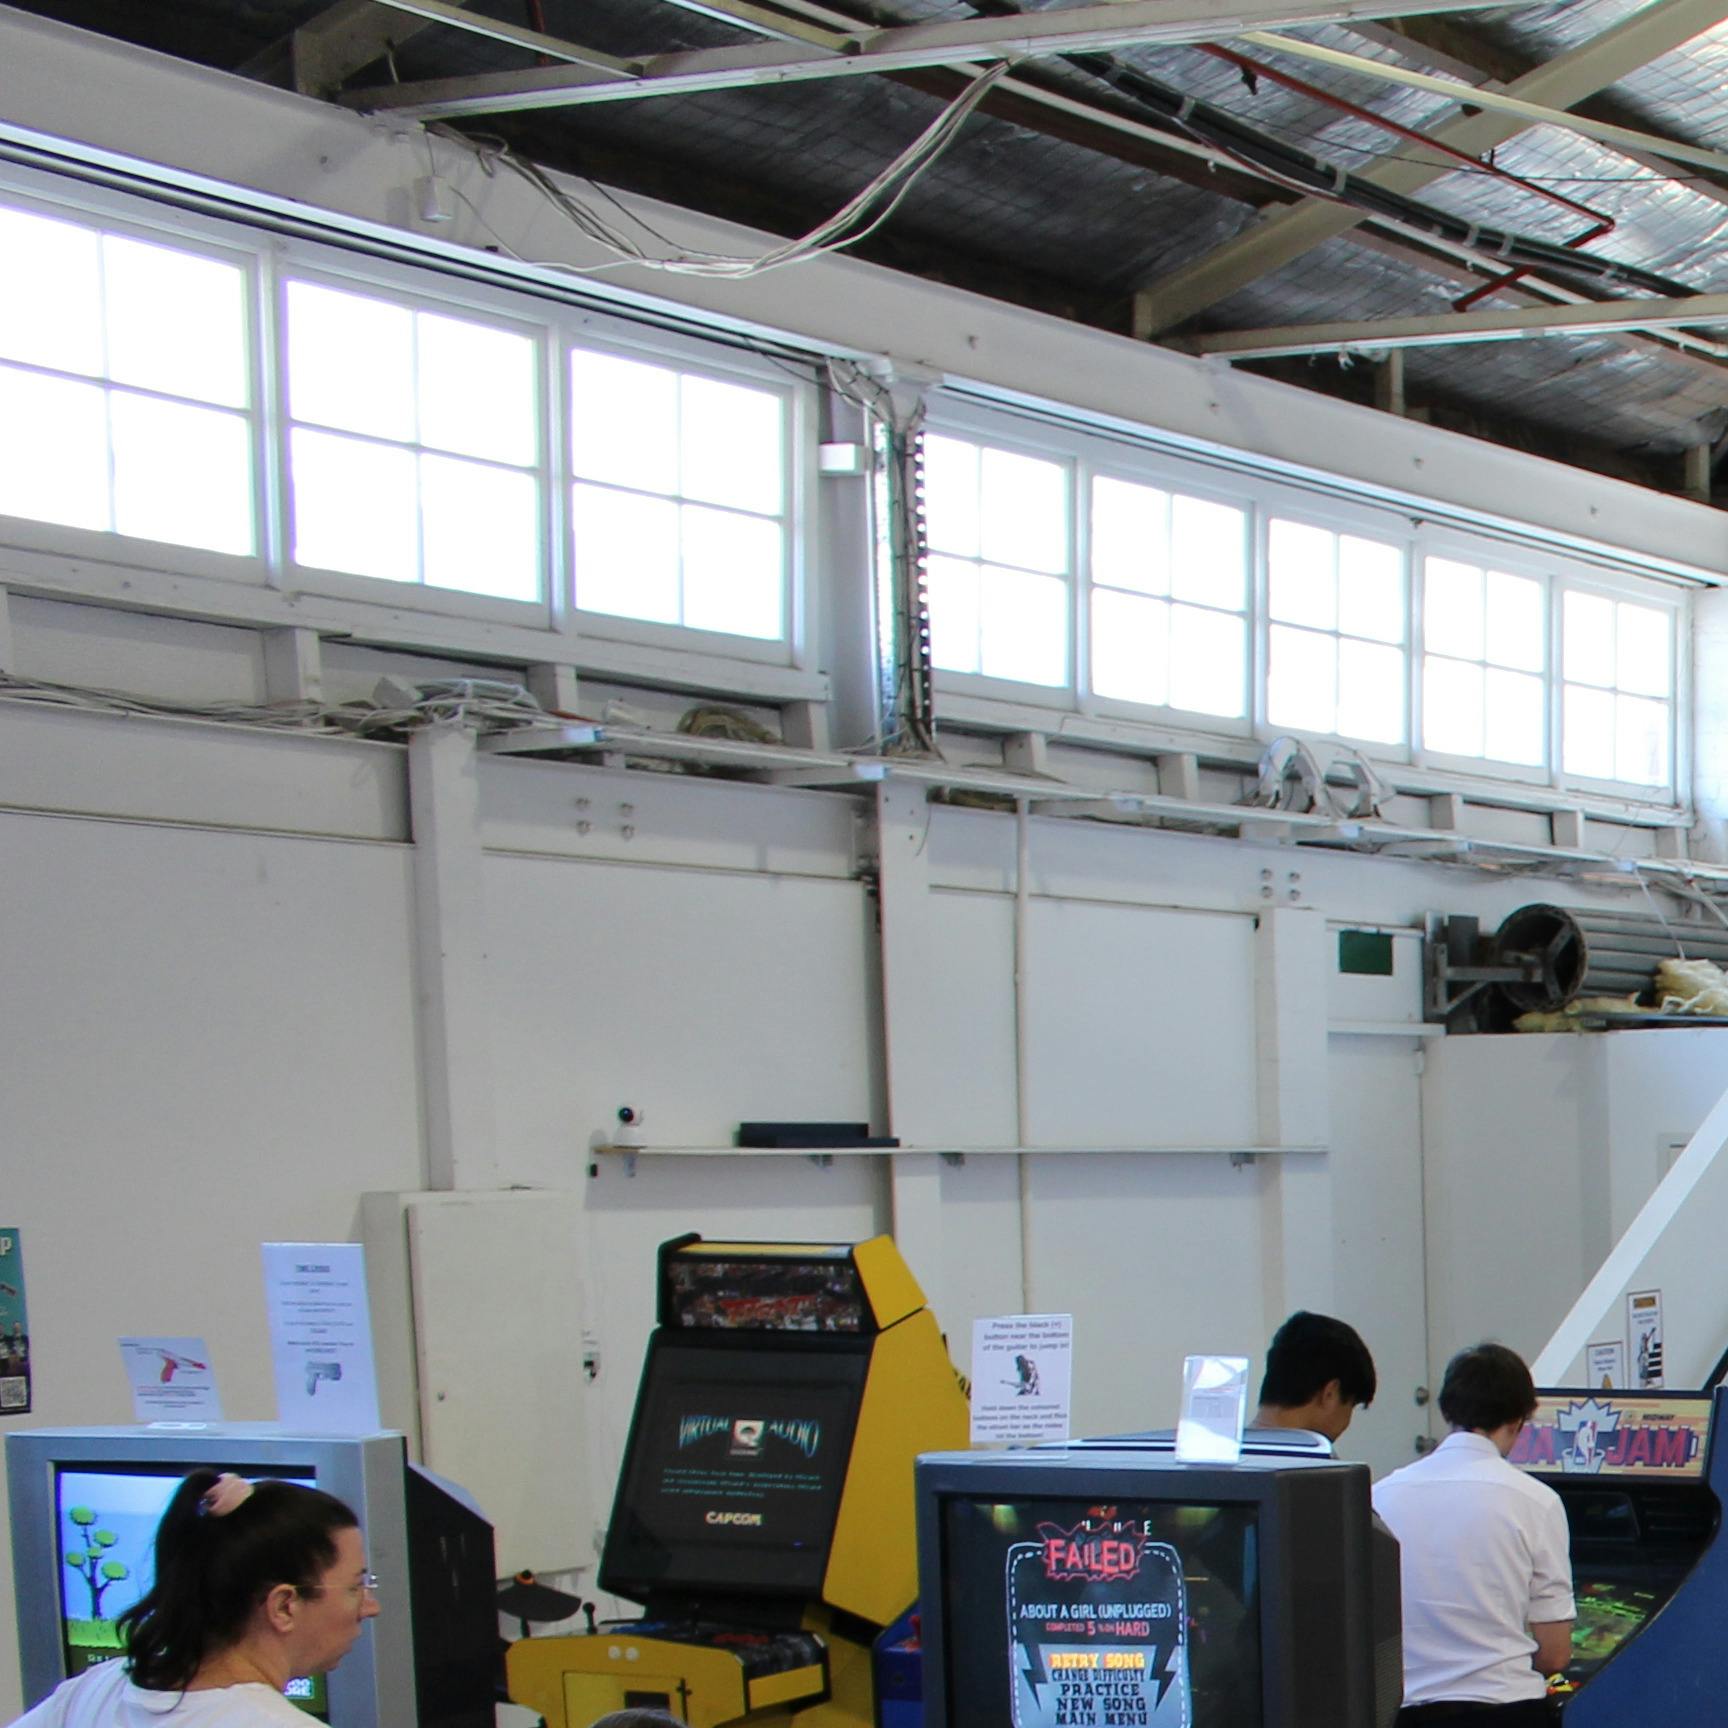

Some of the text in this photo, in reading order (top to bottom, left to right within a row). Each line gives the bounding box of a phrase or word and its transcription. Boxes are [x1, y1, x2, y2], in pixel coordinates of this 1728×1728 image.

[678, 1415, 819, 1458] VIRTUAL AUDIO
[1605, 1424, 1687, 1468] JAM
[705, 1510, 762, 1526] CAPCOM
[1048, 1539, 1135, 1573] FAILED
[1020, 1603, 1172, 1619] ABOUT A GIRL (UNPLUGGED)
[1087, 1620, 1096, 1636] 5
[1116, 1621, 1150, 1636] HARD
[1049, 1652, 1145, 1669] RETRY SONG
[1051, 1669, 1145, 1682] CHANGE DIFFICULTY
[1061, 1683, 1139, 1696] PRACTICE
[1057, 1698, 1146, 1711] NEW SONG
[1056, 1711, 1147, 1726] MAIN MENU
